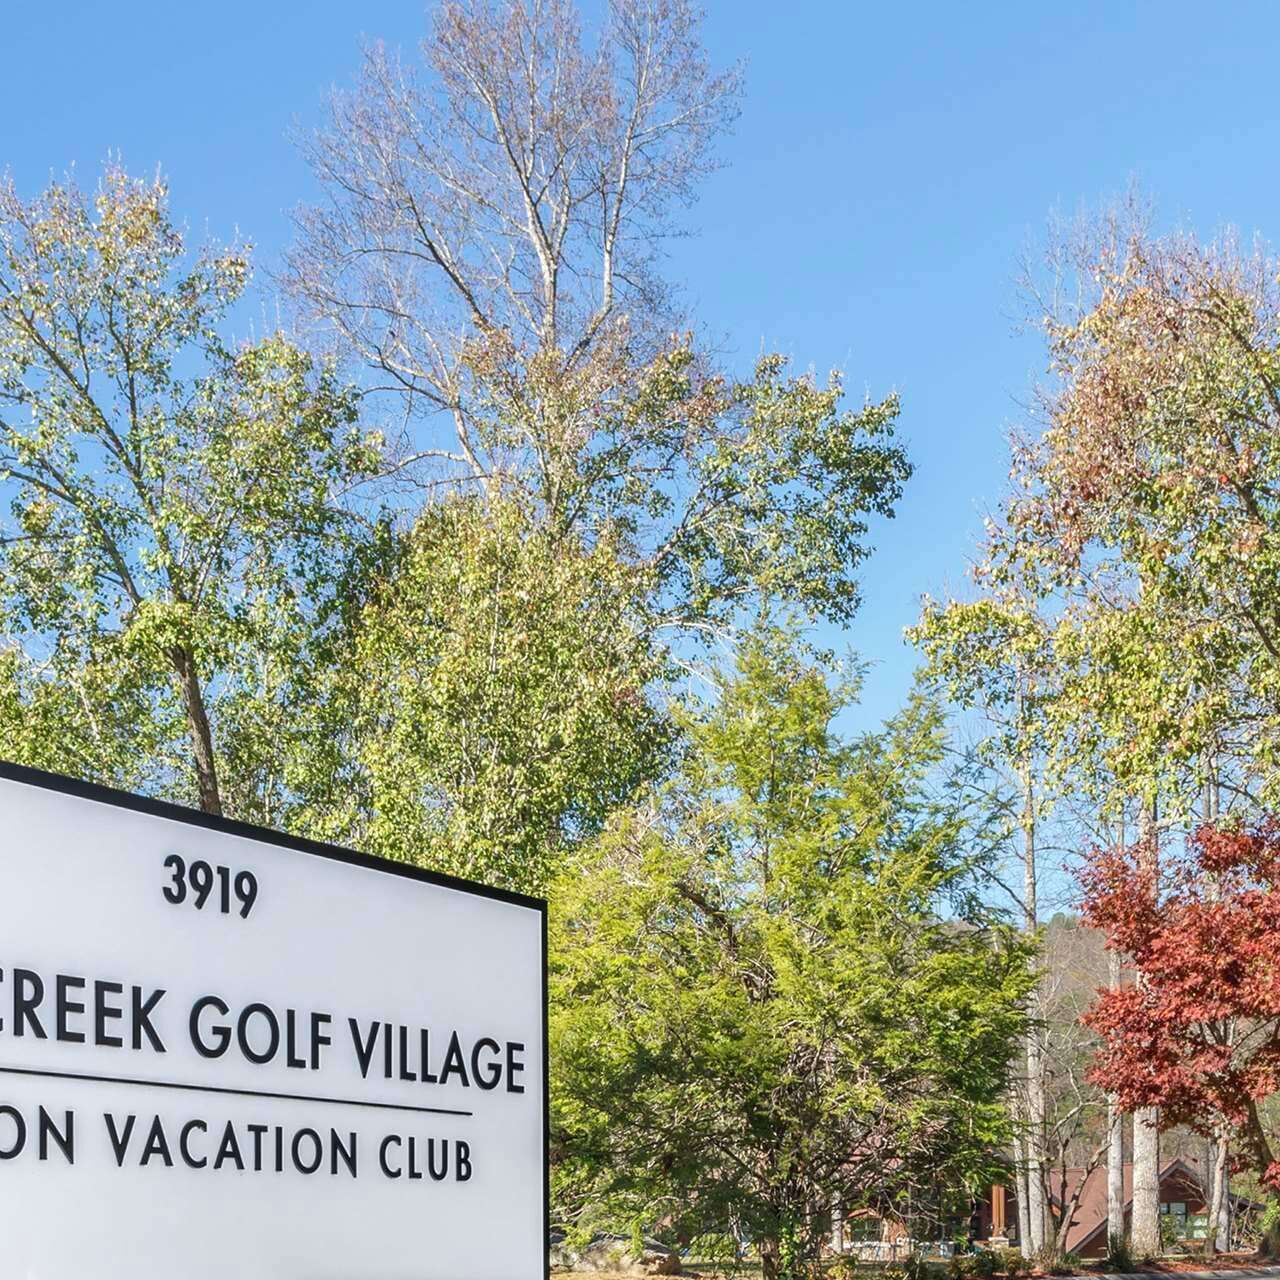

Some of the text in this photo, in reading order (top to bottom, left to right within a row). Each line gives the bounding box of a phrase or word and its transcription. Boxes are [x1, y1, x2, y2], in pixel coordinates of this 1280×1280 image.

[162, 854, 259, 920] 3919
[188, 995, 332, 1071] GOLF
[347, 1017, 526, 1094] VILLAGE
[103, 1113, 357, 1179] VACATION
[379, 1134, 473, 1183] CLUB
